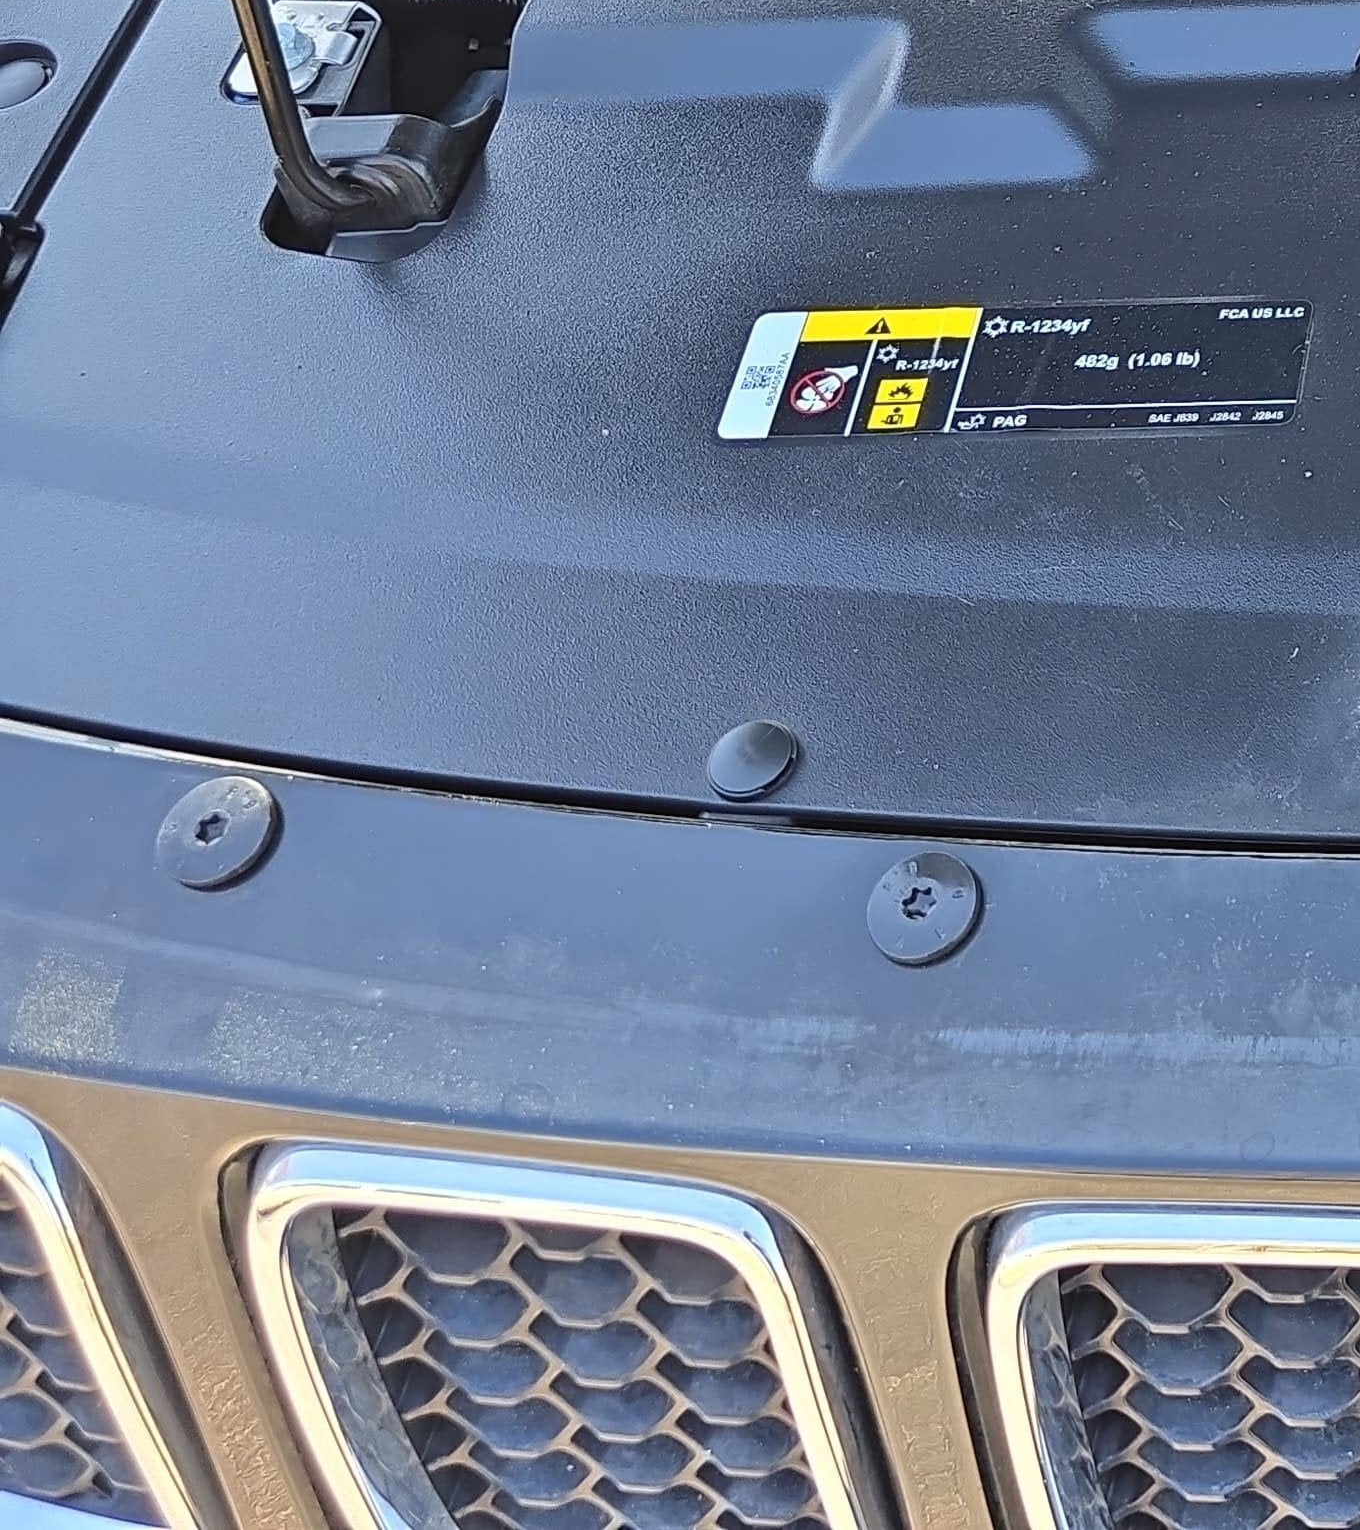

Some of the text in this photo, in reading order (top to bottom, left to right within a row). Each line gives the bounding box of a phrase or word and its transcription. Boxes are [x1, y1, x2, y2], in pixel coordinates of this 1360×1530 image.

[1218, 306, 1305, 320] FCA US LLC
[1010, 318, 1092, 335] R-1234yf
[895, 358, 960, 372] R-1234yf
[1073, 354, 1120, 370] 482g
[992, 415, 1027, 427] PAG
[1148, 413, 1172, 424] SAE
